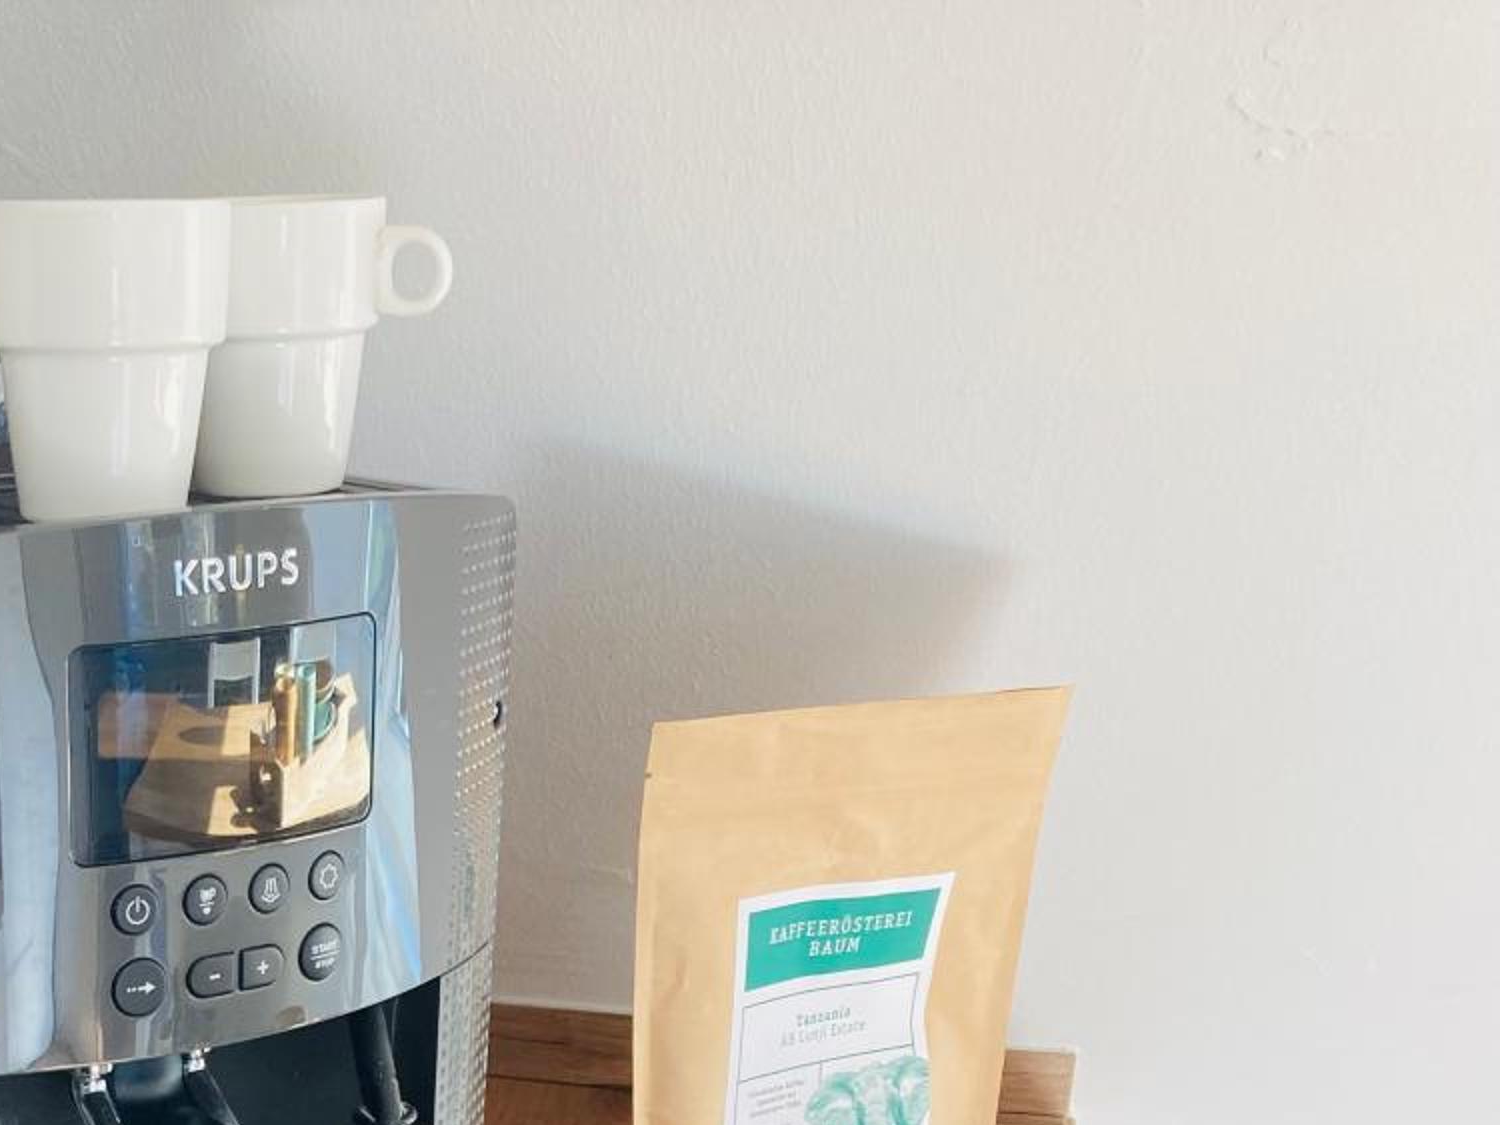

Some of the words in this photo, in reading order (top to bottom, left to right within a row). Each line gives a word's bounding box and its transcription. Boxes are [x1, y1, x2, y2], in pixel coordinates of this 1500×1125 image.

[173, 547, 300, 597] KRUPS
[769, 910, 914, 945] KAFFEERÖSTEREI
[808, 936, 861, 957] BAUM
[796, 1006, 852, 1028] Tanzania
